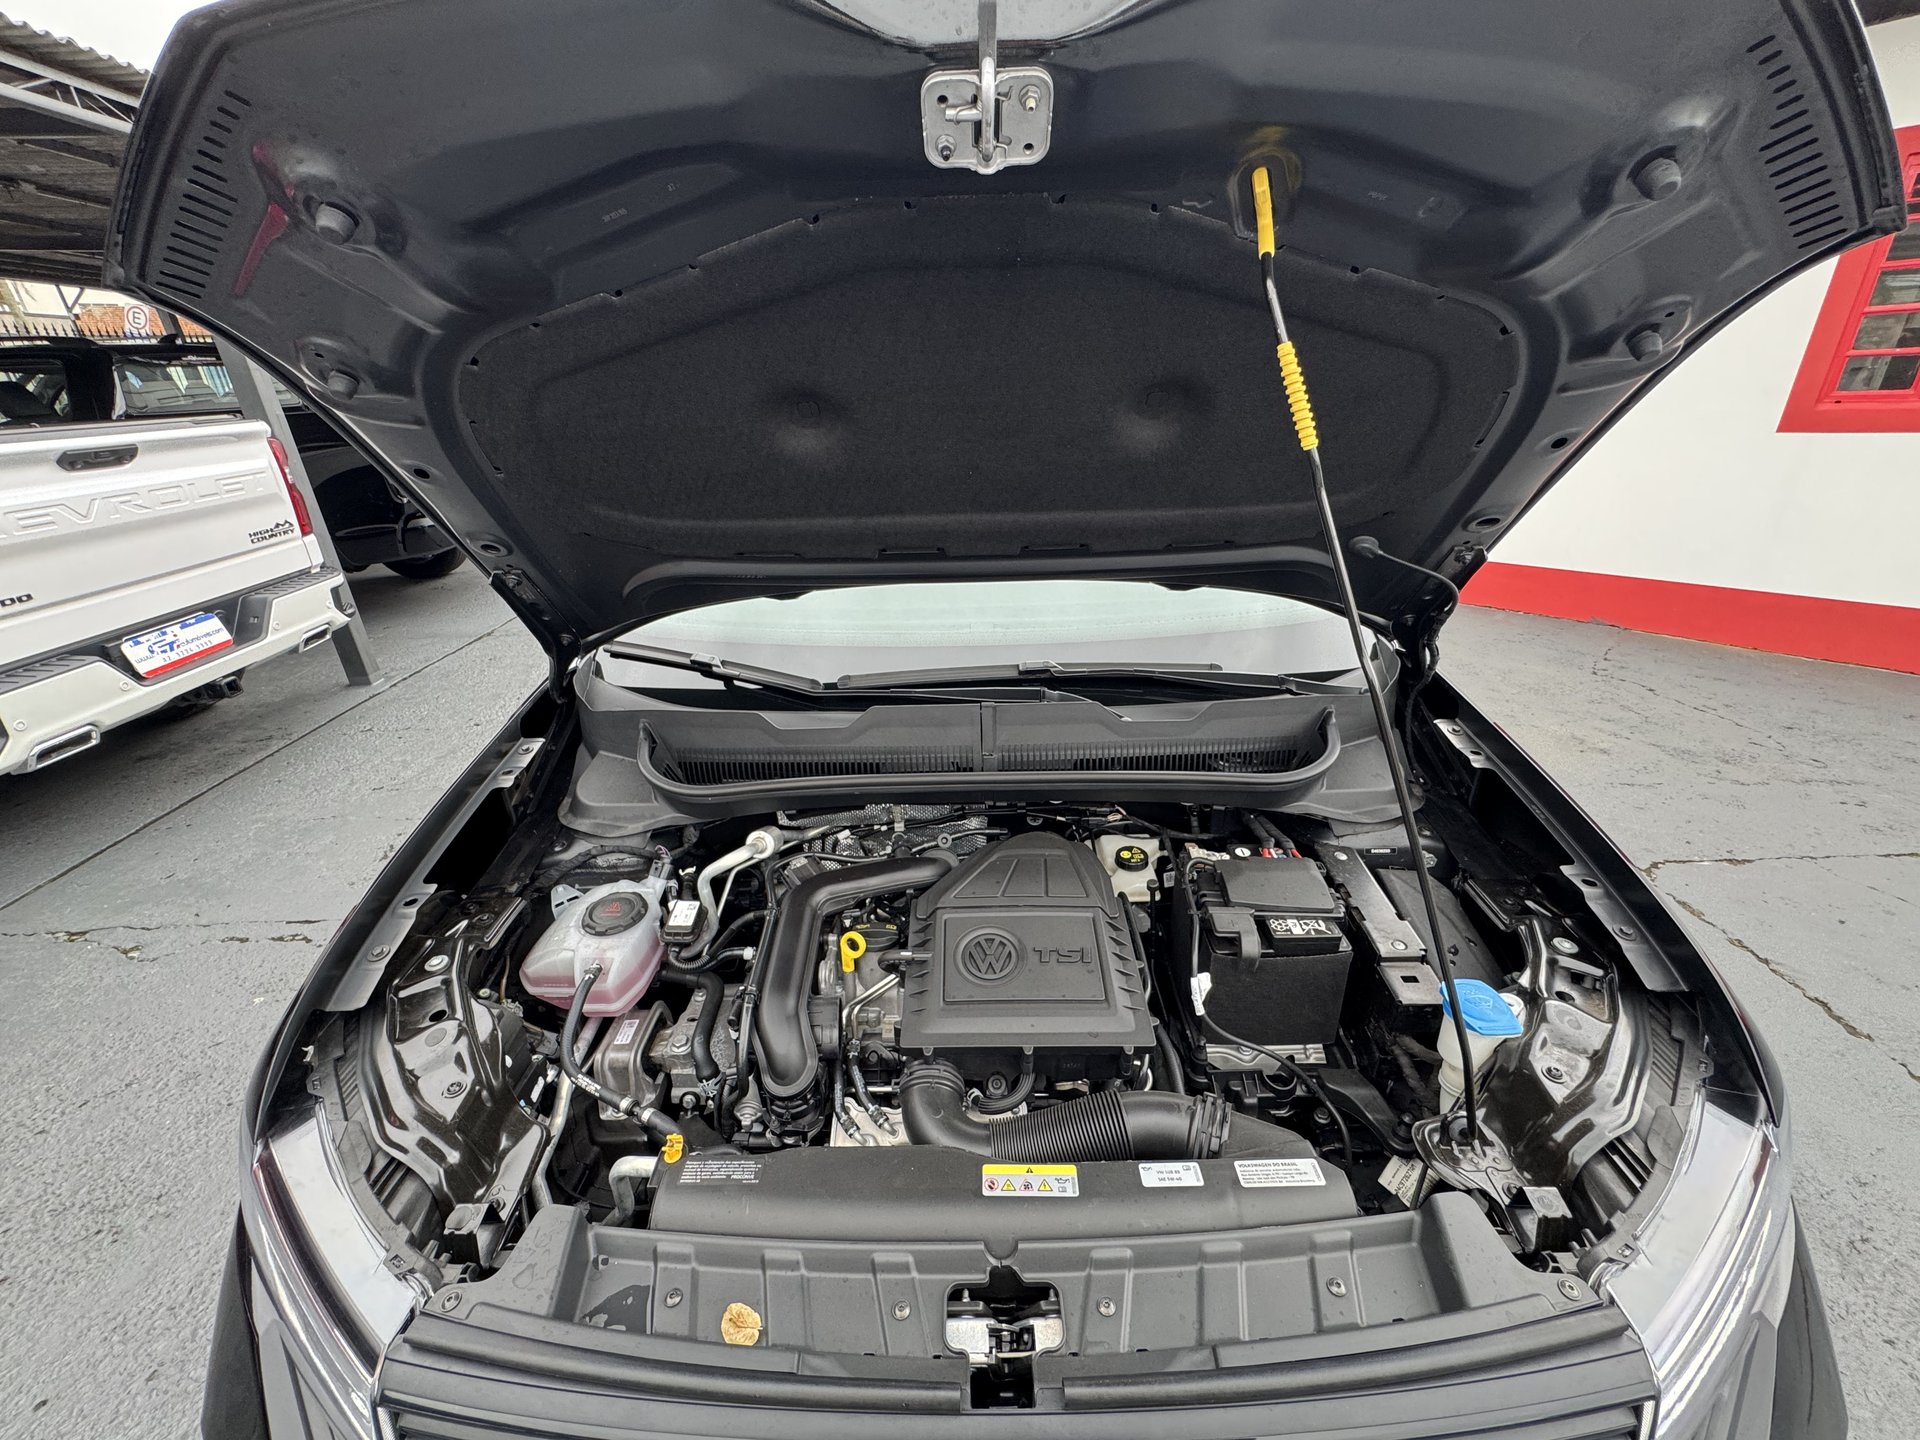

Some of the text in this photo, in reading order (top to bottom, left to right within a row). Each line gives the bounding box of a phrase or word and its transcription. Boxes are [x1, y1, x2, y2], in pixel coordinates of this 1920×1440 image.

[132, 311, 142, 325] E
[0, 470, 268, 539] EVROLET
[248, 528, 274, 538] HIGH
[251, 528, 295, 544] COUNTRY
[1033, 947, 1092, 963] TSI
